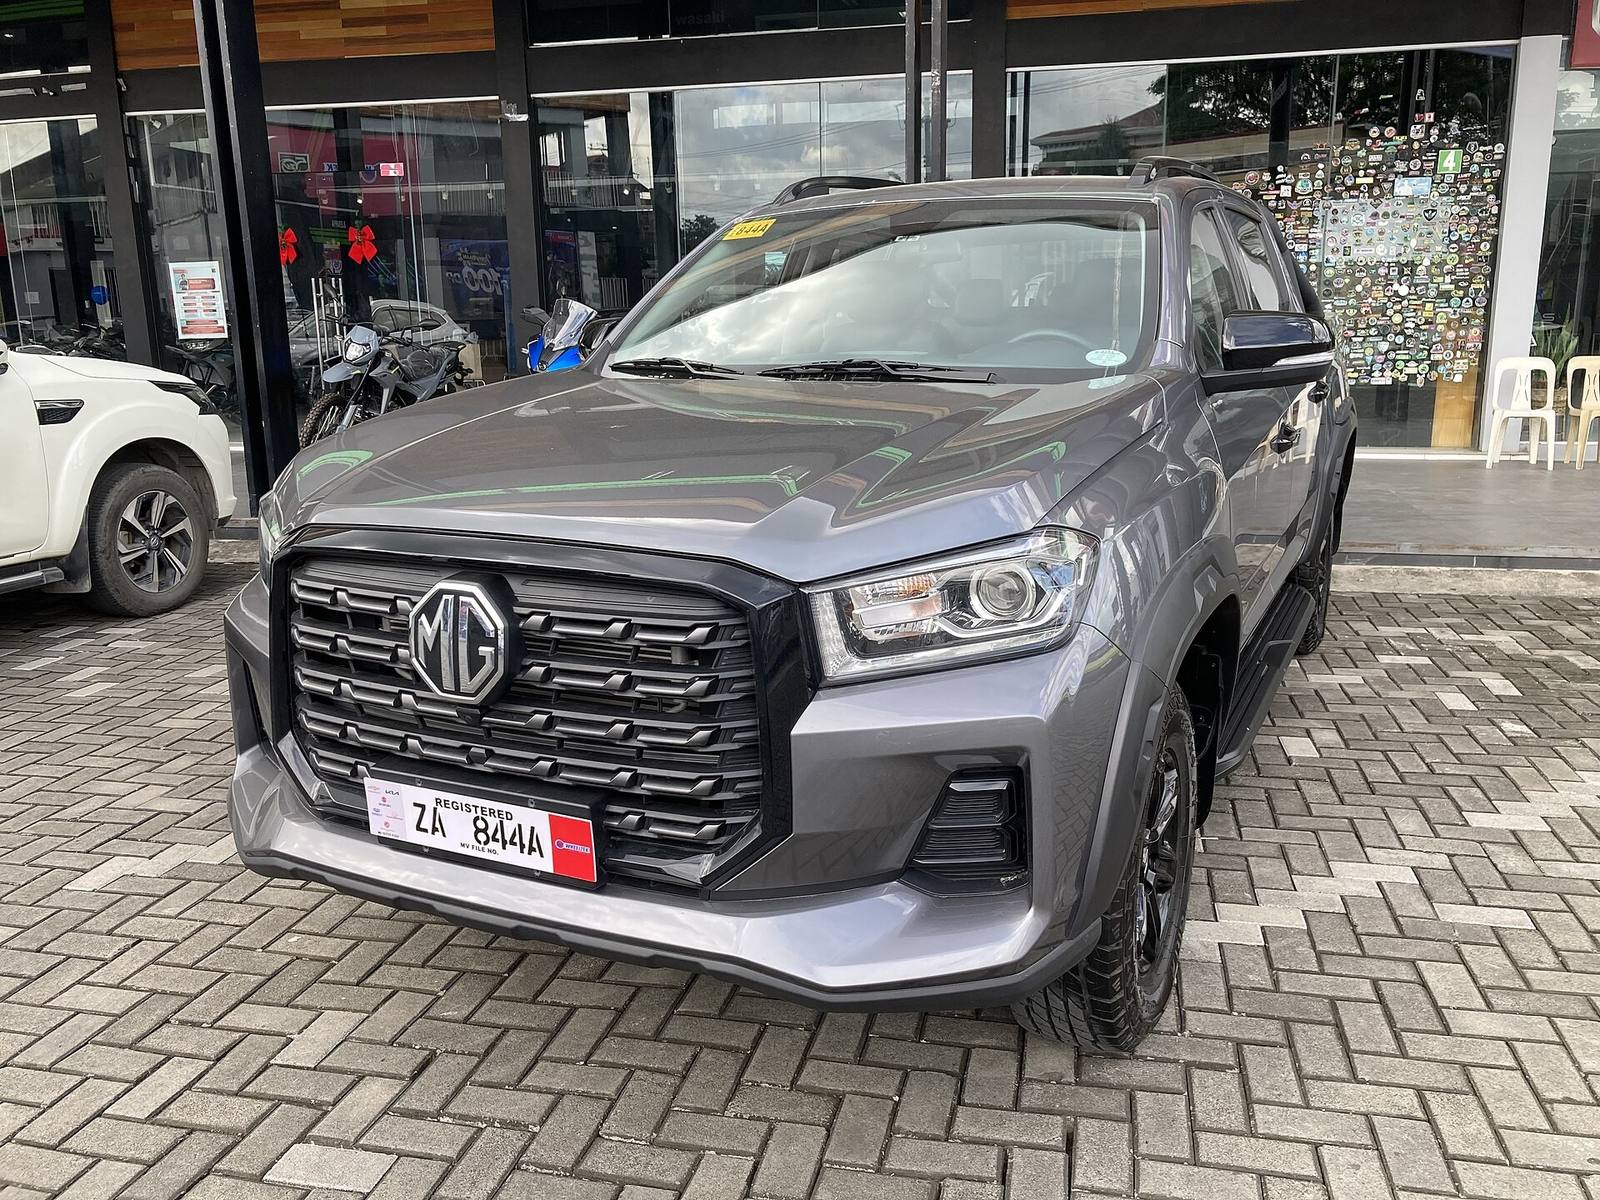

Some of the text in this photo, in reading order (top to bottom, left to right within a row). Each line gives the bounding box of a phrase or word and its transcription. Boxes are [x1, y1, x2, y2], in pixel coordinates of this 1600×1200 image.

[418, 594, 495, 693] MG
[435, 797, 513, 821] REGISTERED
[412, 802, 545, 858] ZA 844A
[460, 842, 500, 856] MV FILE NO.
